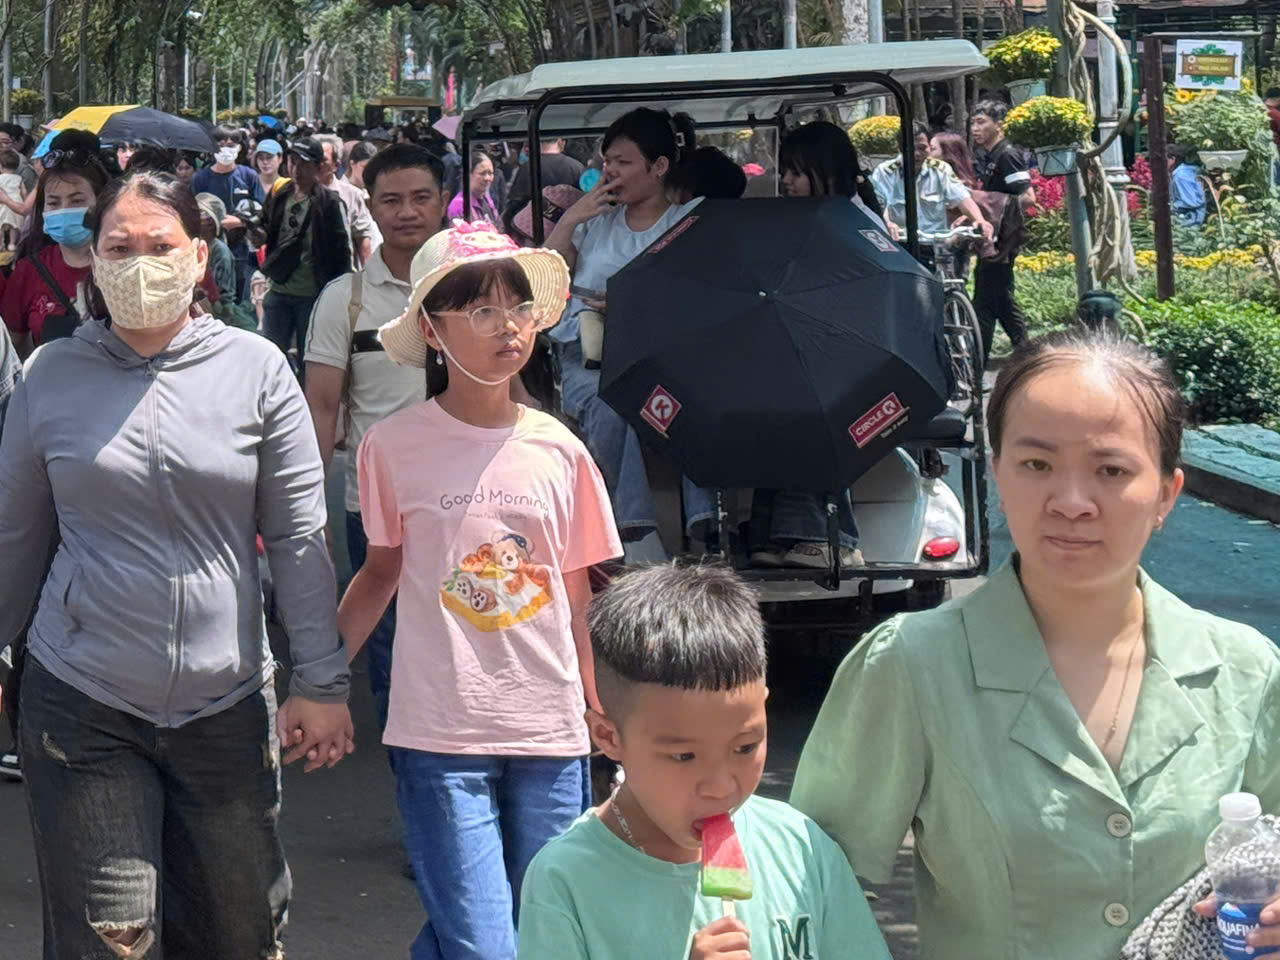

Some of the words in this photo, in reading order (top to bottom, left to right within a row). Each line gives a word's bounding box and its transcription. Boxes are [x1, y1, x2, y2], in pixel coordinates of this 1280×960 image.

[855, 410, 885, 436] CIRCLE
[440, 485, 485, 510] Good
[489, 489, 550, 520] Morning
[775, 914, 814, 960] M
